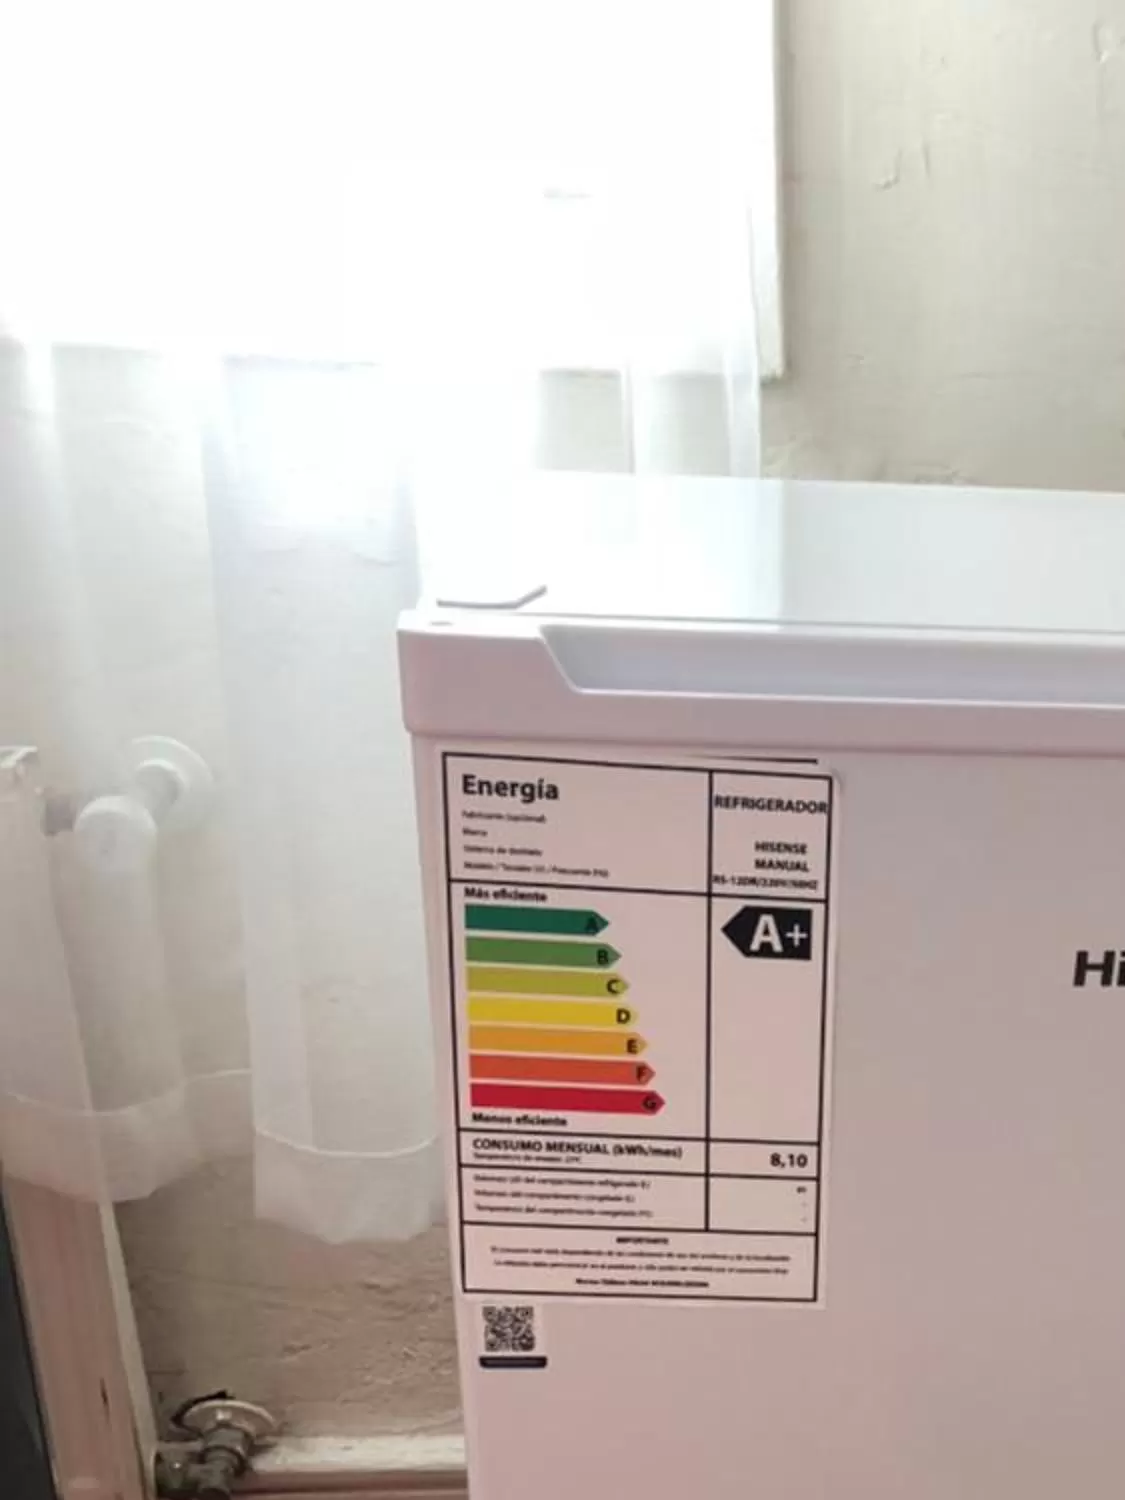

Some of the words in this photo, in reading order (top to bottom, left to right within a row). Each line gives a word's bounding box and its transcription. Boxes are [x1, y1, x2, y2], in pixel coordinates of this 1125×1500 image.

[462, 773, 560, 802] Energía
[713, 795, 829, 814] REFRIGERADOR
[754, 841, 807, 855] HISENSE
[754, 858, 810, 873] MANUAL
[464, 885, 490, 899] Más
[491, 887, 548, 902] eficiente
[584, 916, 599, 932] A
[748, 913, 808, 954] A+
[596, 949, 610, 964] B
[605, 978, 621, 995] C
[615, 1008, 631, 1024] D
[626, 1038, 639, 1054] E
[635, 1066, 648, 1082] F
[642, 1095, 658, 1111] G
[471, 1111, 513, 1125] Menos
[515, 1113, 568, 1128] eficiente
[472, 1138, 544, 1152] CONSUMO
[545, 1141, 611, 1155] MENSUAL
[769, 1151, 809, 1170] 8,10
